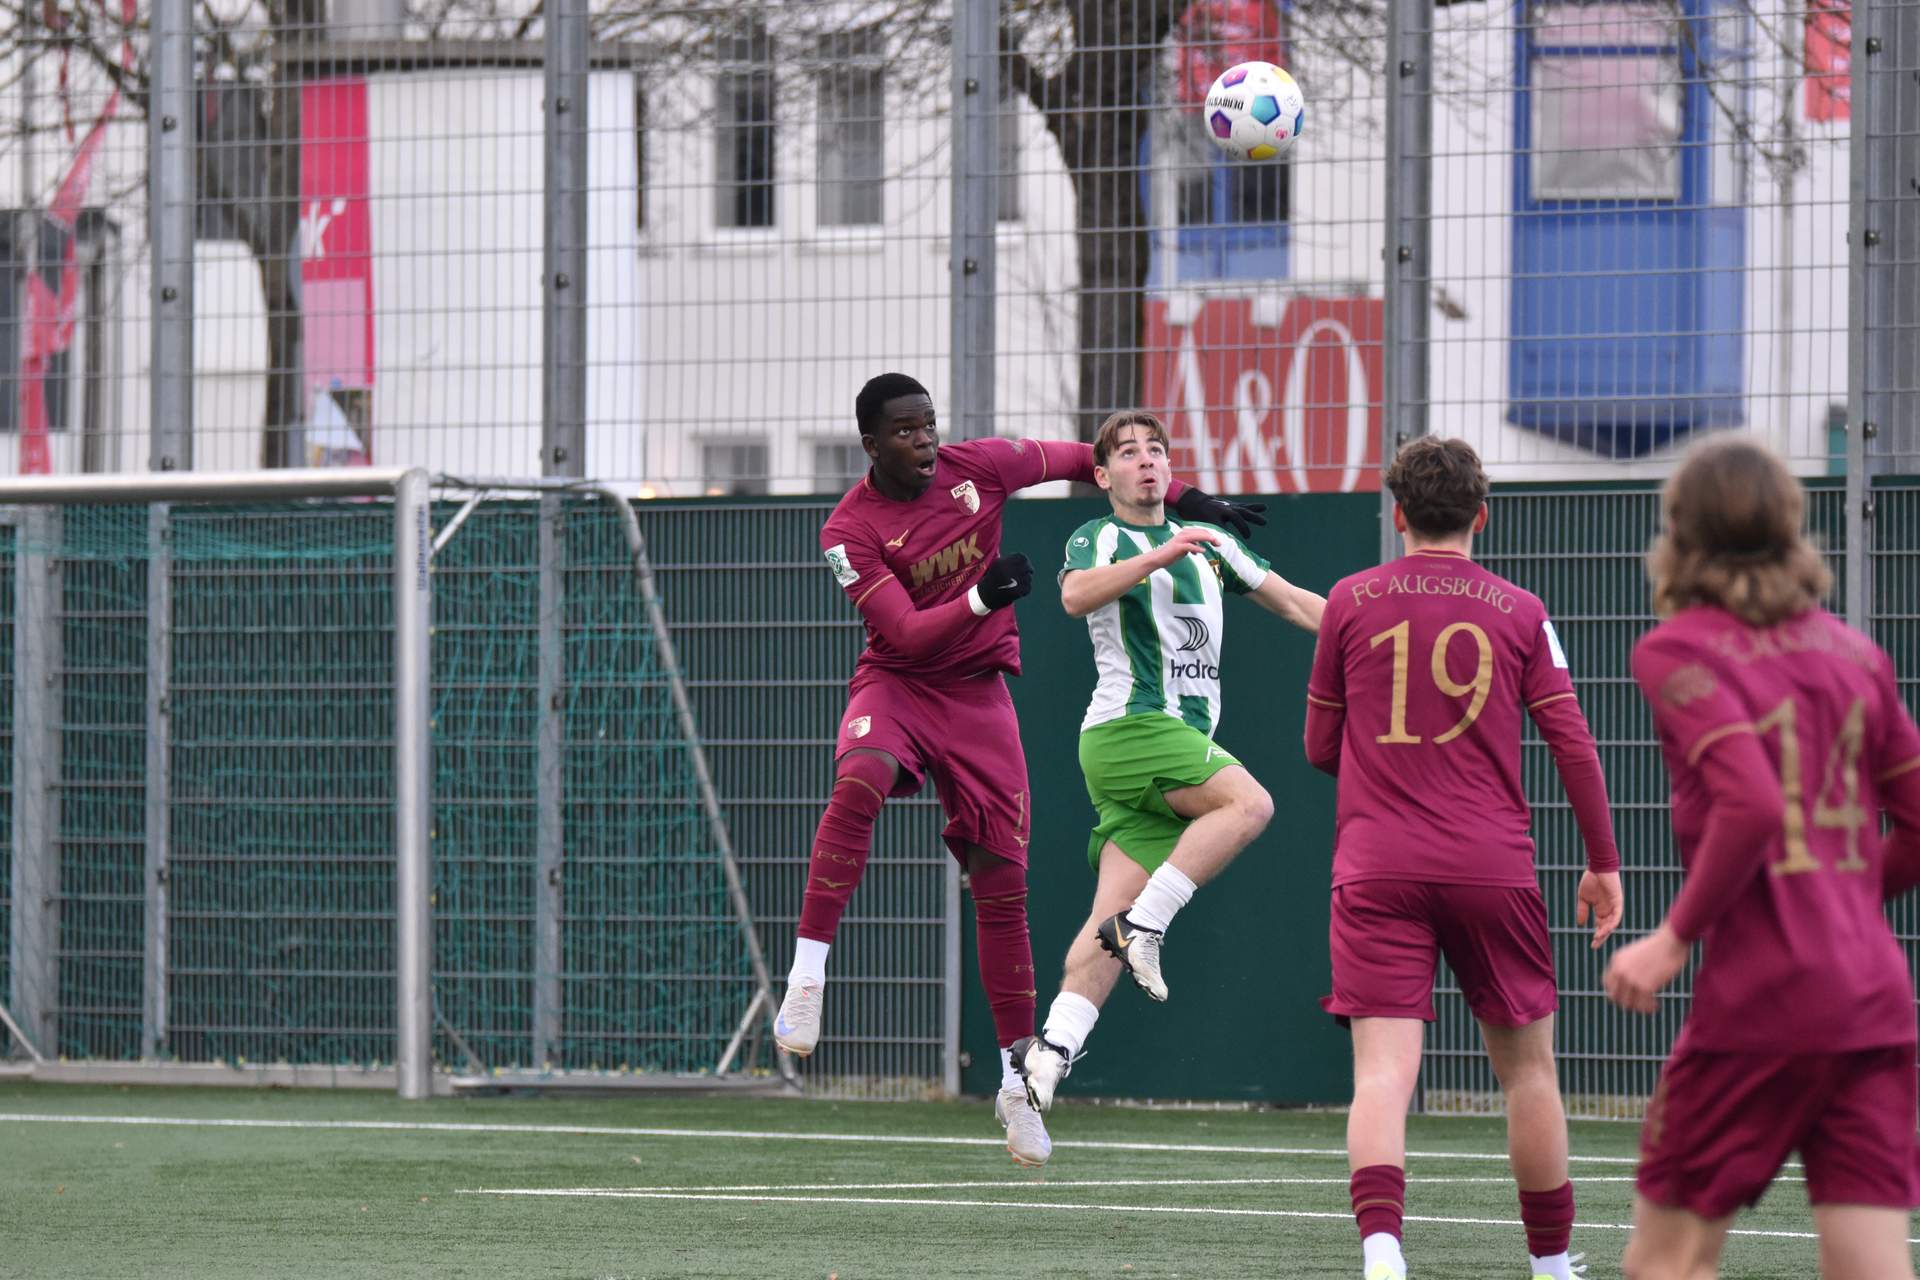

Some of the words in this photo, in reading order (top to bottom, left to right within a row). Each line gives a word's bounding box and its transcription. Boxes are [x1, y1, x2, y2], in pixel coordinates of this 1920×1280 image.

[1206, 96, 1244, 111] DERBYS
[909, 531, 984, 588] WWK
[1351, 578, 1383, 607] FC
[1387, 574, 1517, 614] AUGSBURG
[1369, 619, 1493, 744] 19
[1756, 696, 1868, 877] 14
[816, 849, 859, 868] FCA
